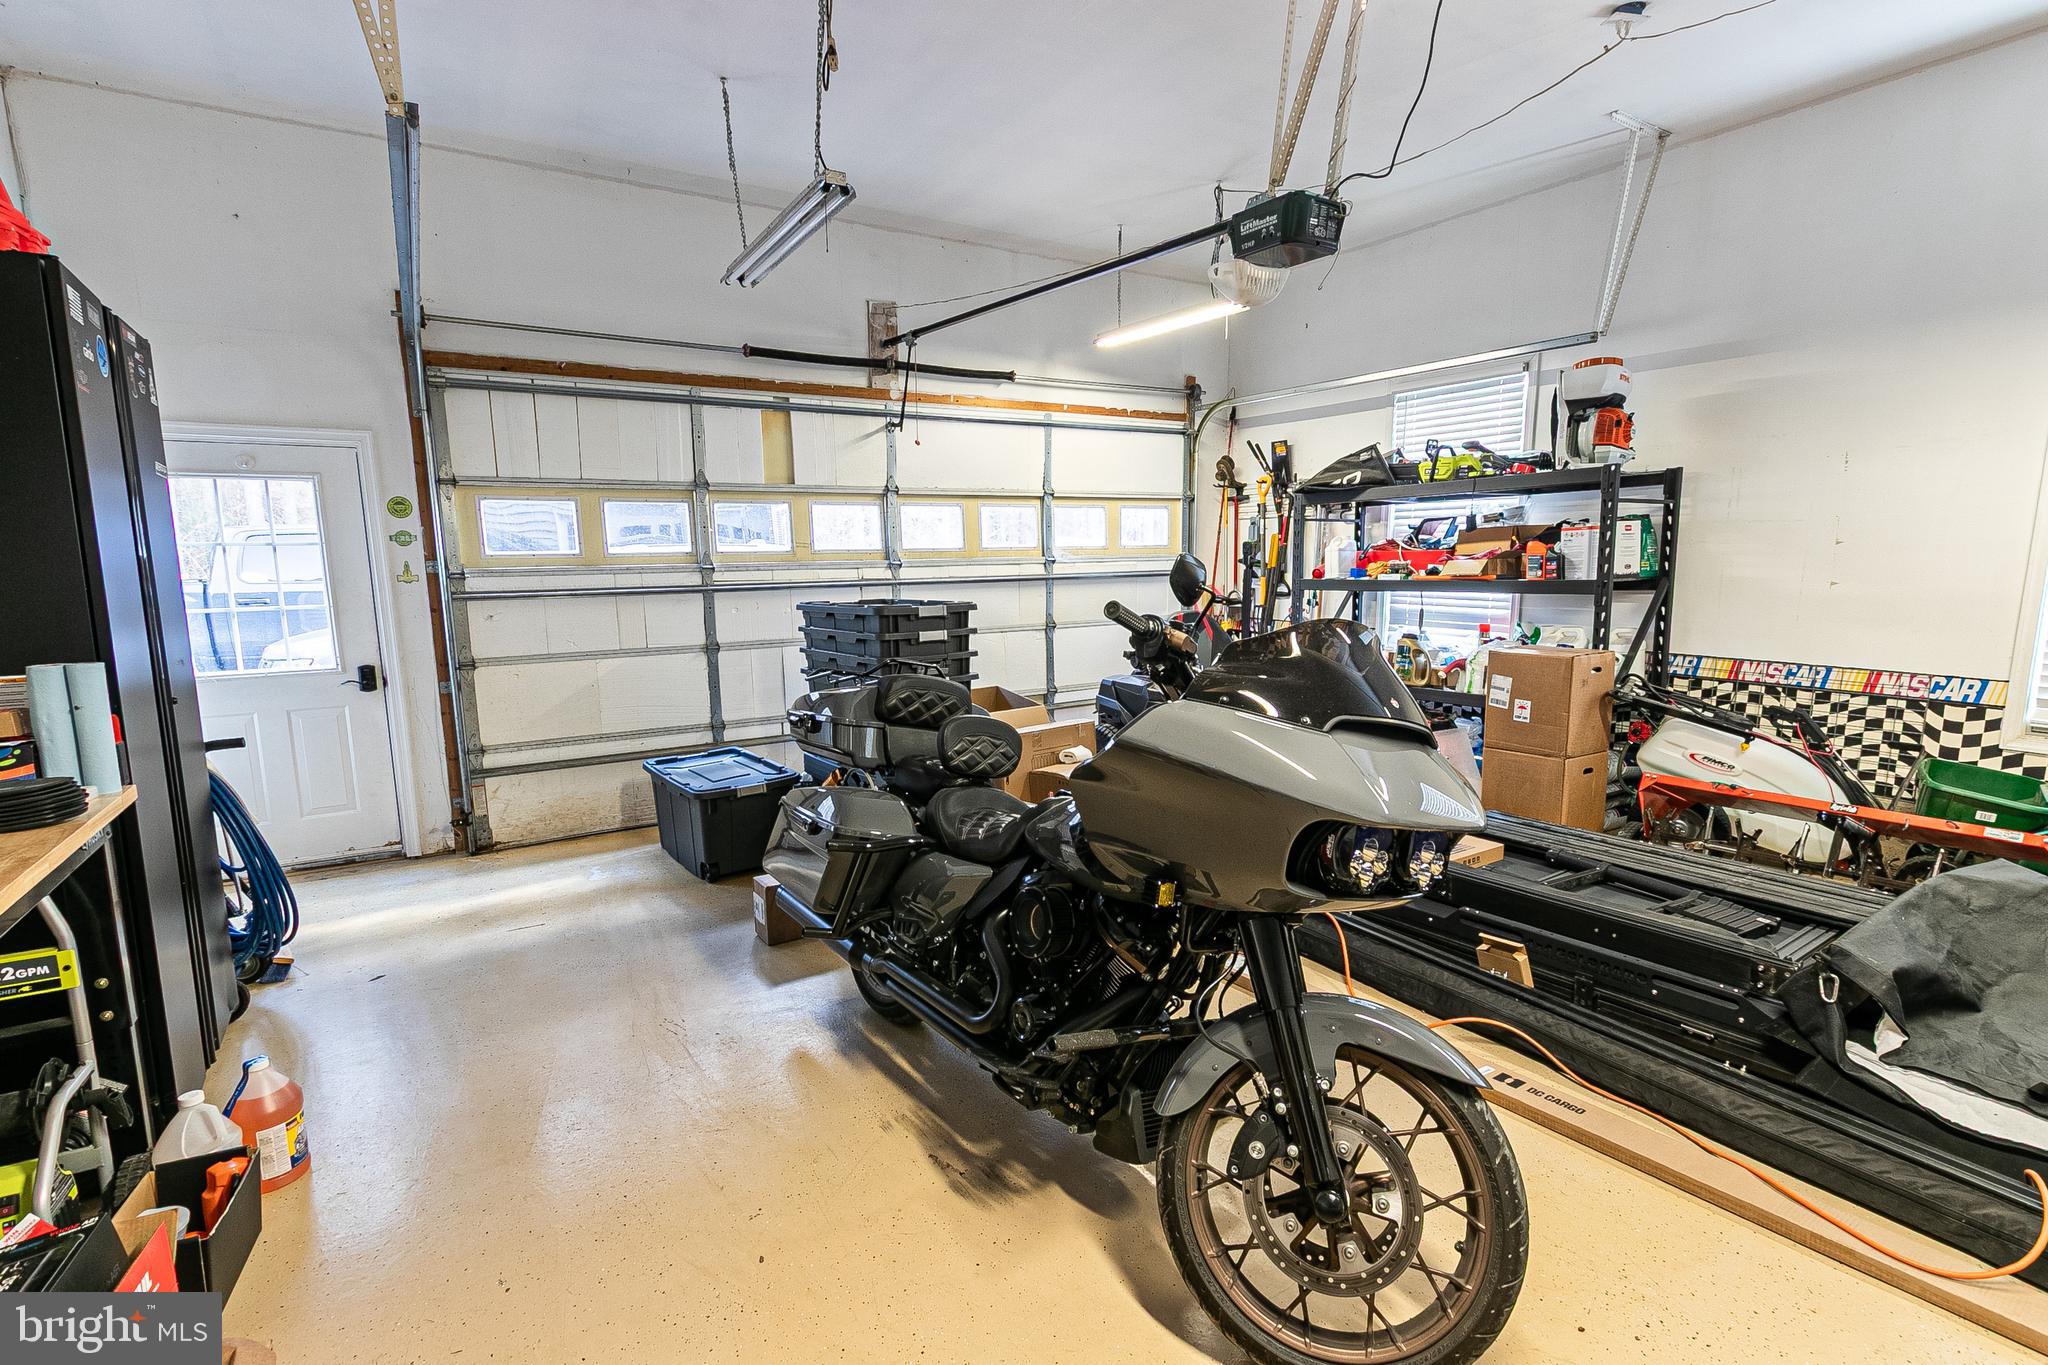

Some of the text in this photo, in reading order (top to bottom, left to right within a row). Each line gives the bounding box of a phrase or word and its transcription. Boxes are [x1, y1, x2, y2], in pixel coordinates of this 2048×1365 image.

[1739, 660, 1827, 689] NASCAR
[1875, 671, 1982, 704] NASCAR
[1702, 756, 1736, 770] FIMCO
[1526, 1087, 1587, 1115] DC CARGO
